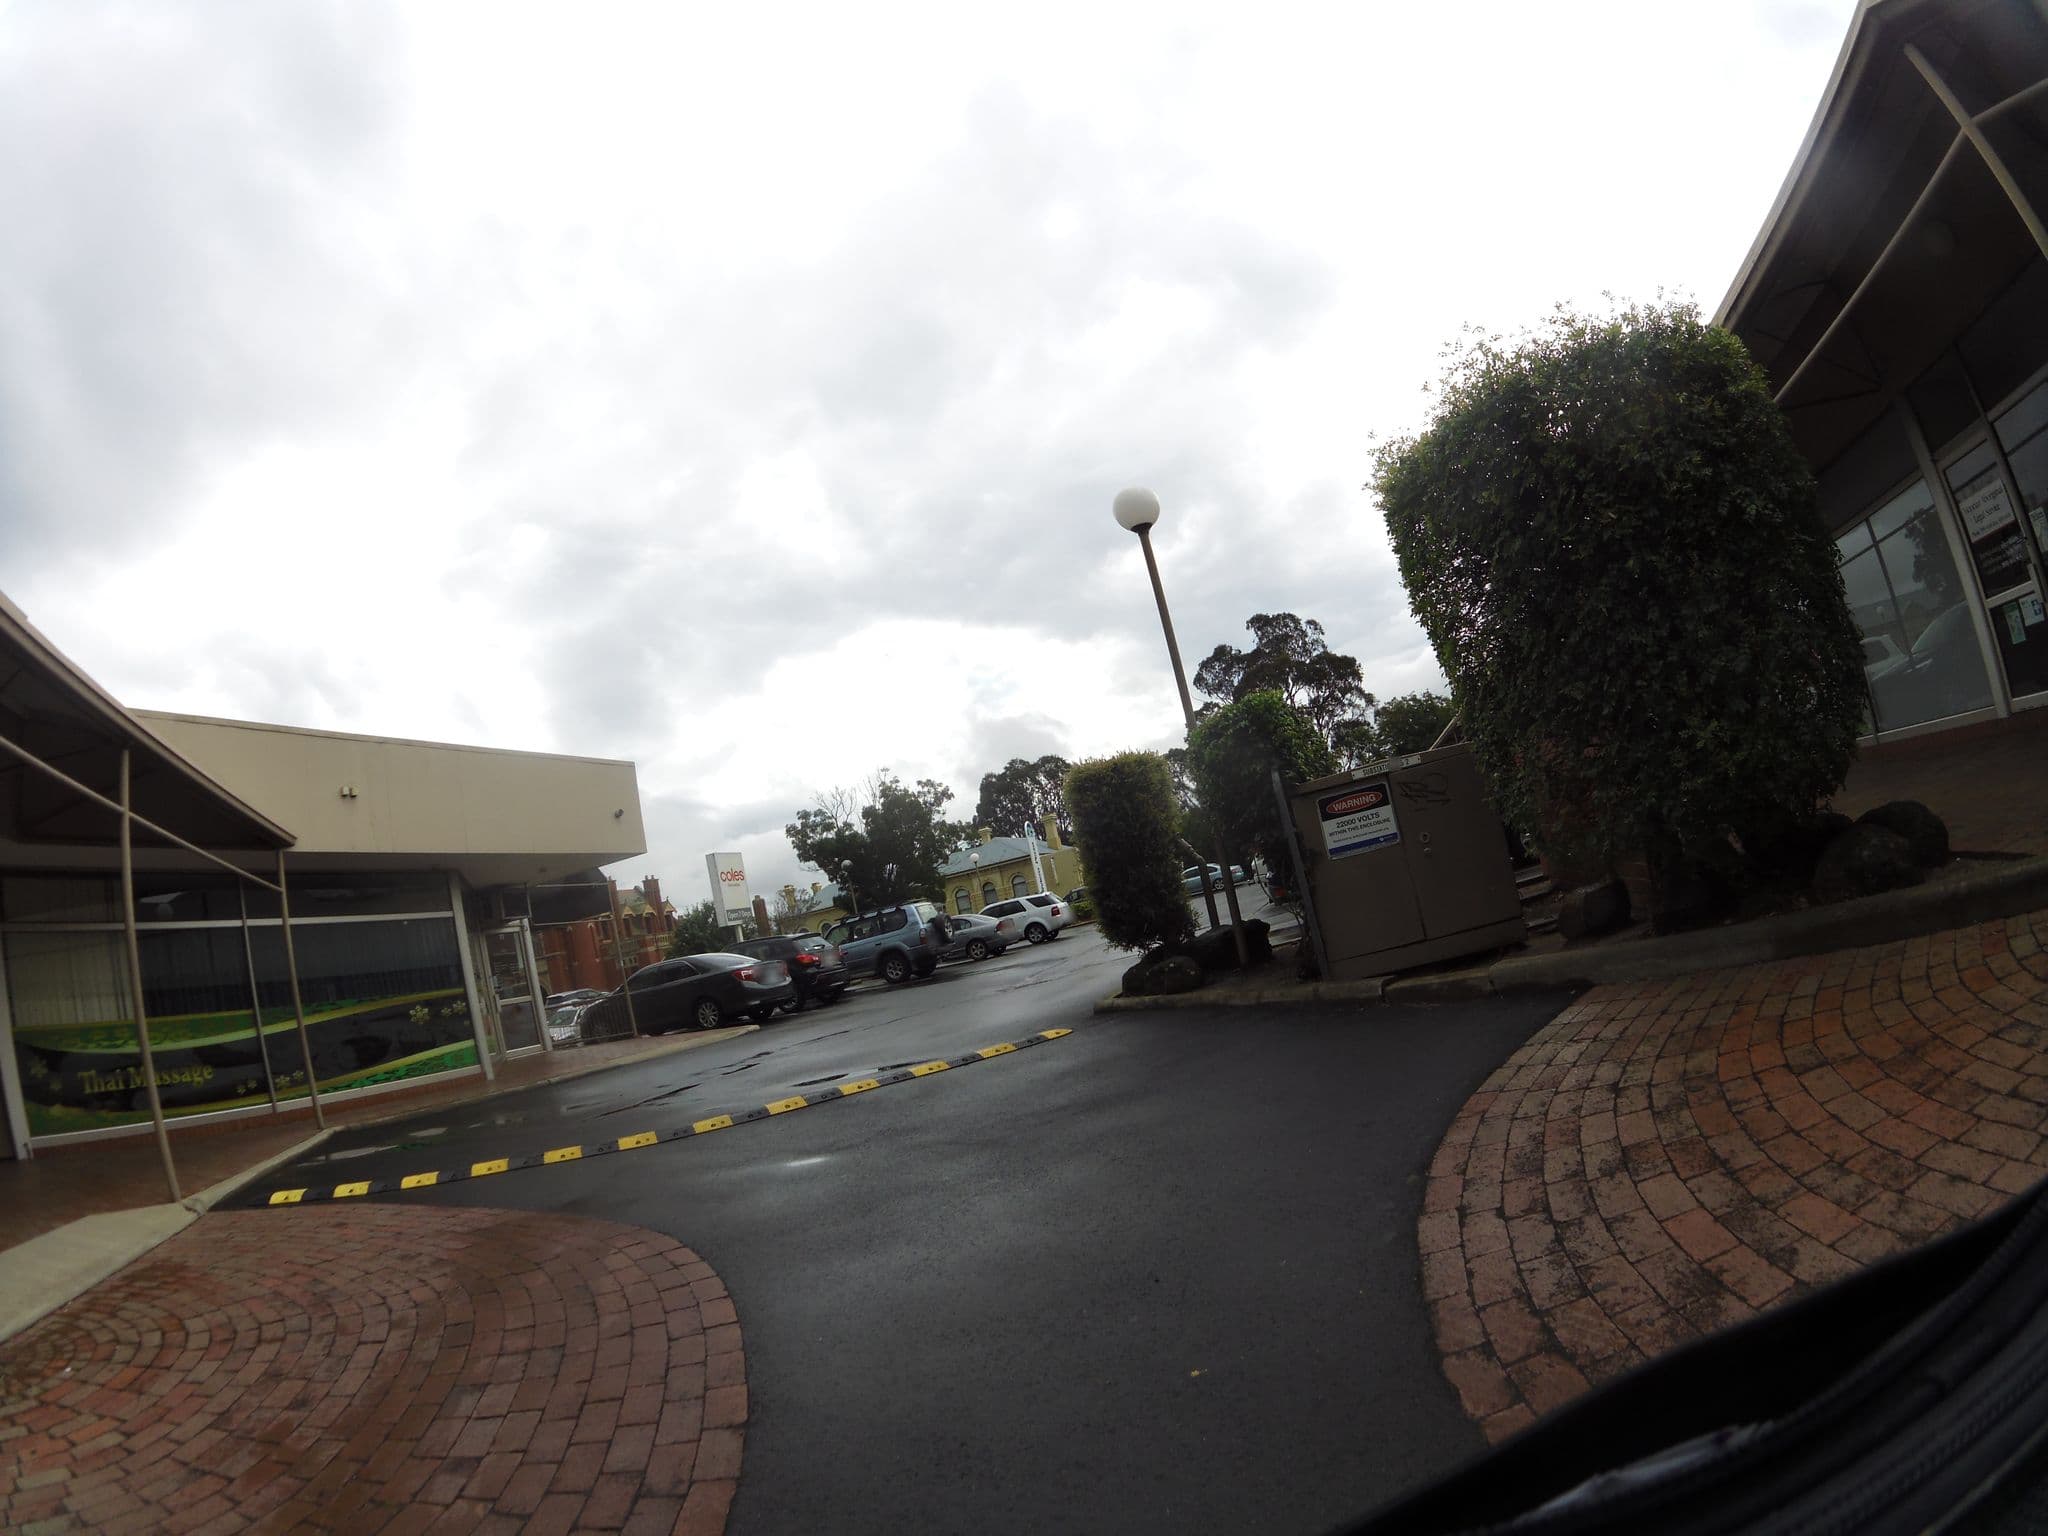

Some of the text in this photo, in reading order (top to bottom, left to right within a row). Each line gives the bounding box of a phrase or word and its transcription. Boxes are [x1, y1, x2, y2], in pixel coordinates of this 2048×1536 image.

[1332, 793, 1376, 811] WARNING
[1336, 812, 1380, 829] 22000 VOLTS
[1359, 817, 1391, 828] ENCLOSURE
[720, 867, 745, 882] coles
[77, 1069, 124, 1094] Thai
